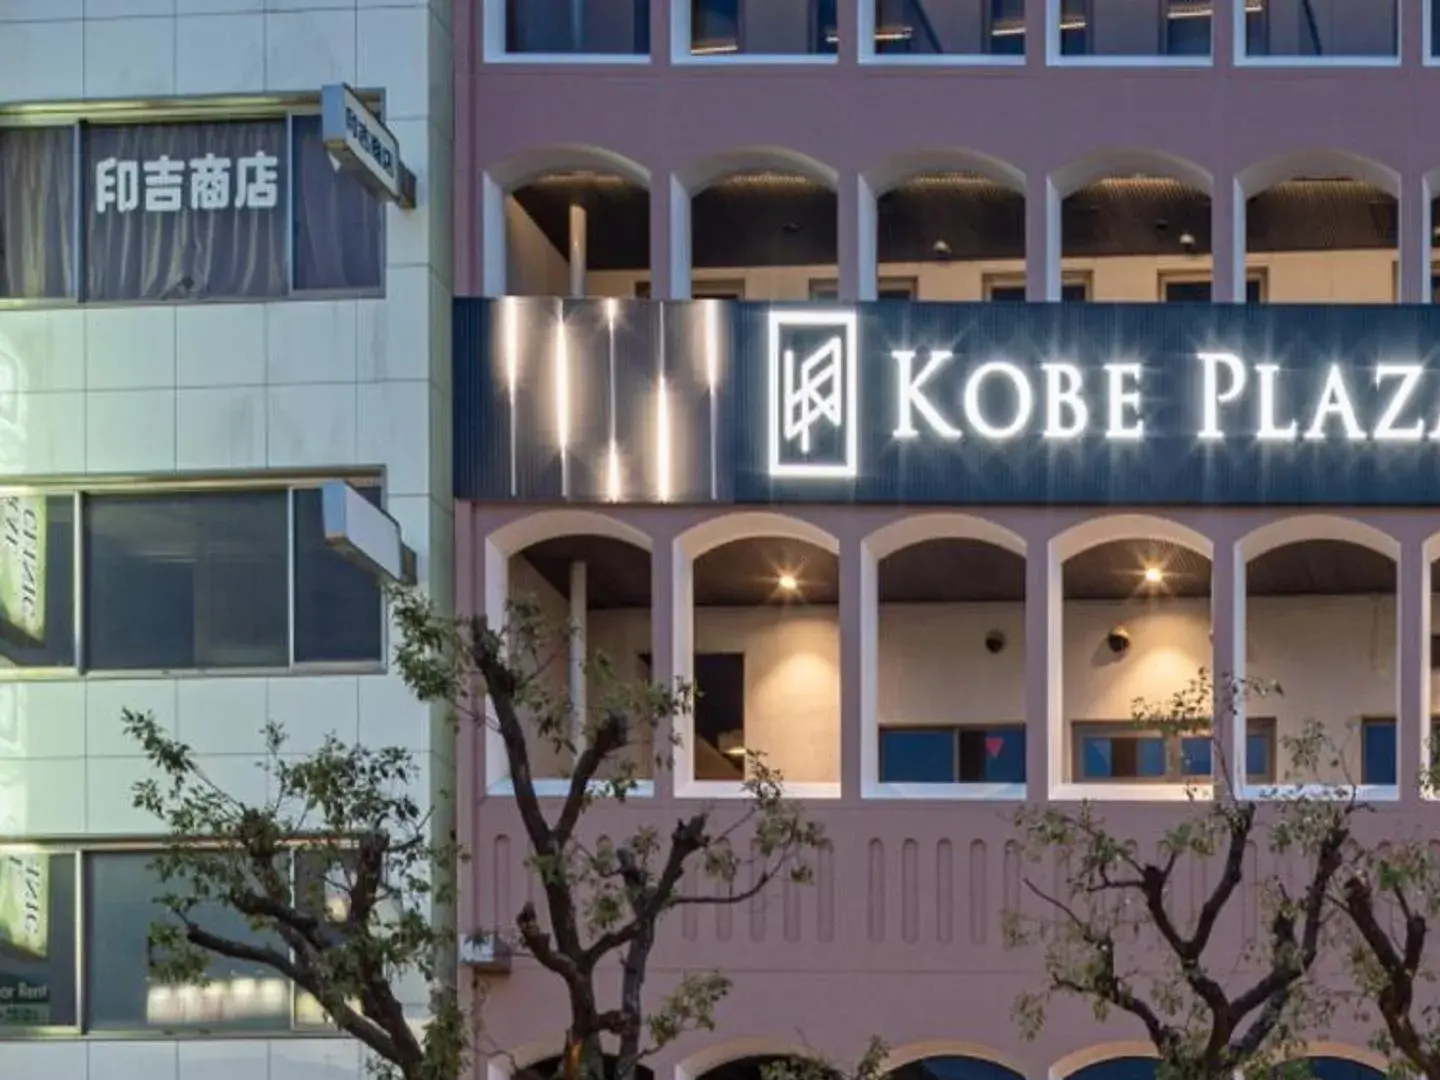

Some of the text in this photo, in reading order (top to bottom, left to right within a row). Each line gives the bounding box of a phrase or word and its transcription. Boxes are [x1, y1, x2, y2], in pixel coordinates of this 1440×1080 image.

[95, 151, 279, 213] 印吉商店
[890, 349, 1146, 441] KOBE
